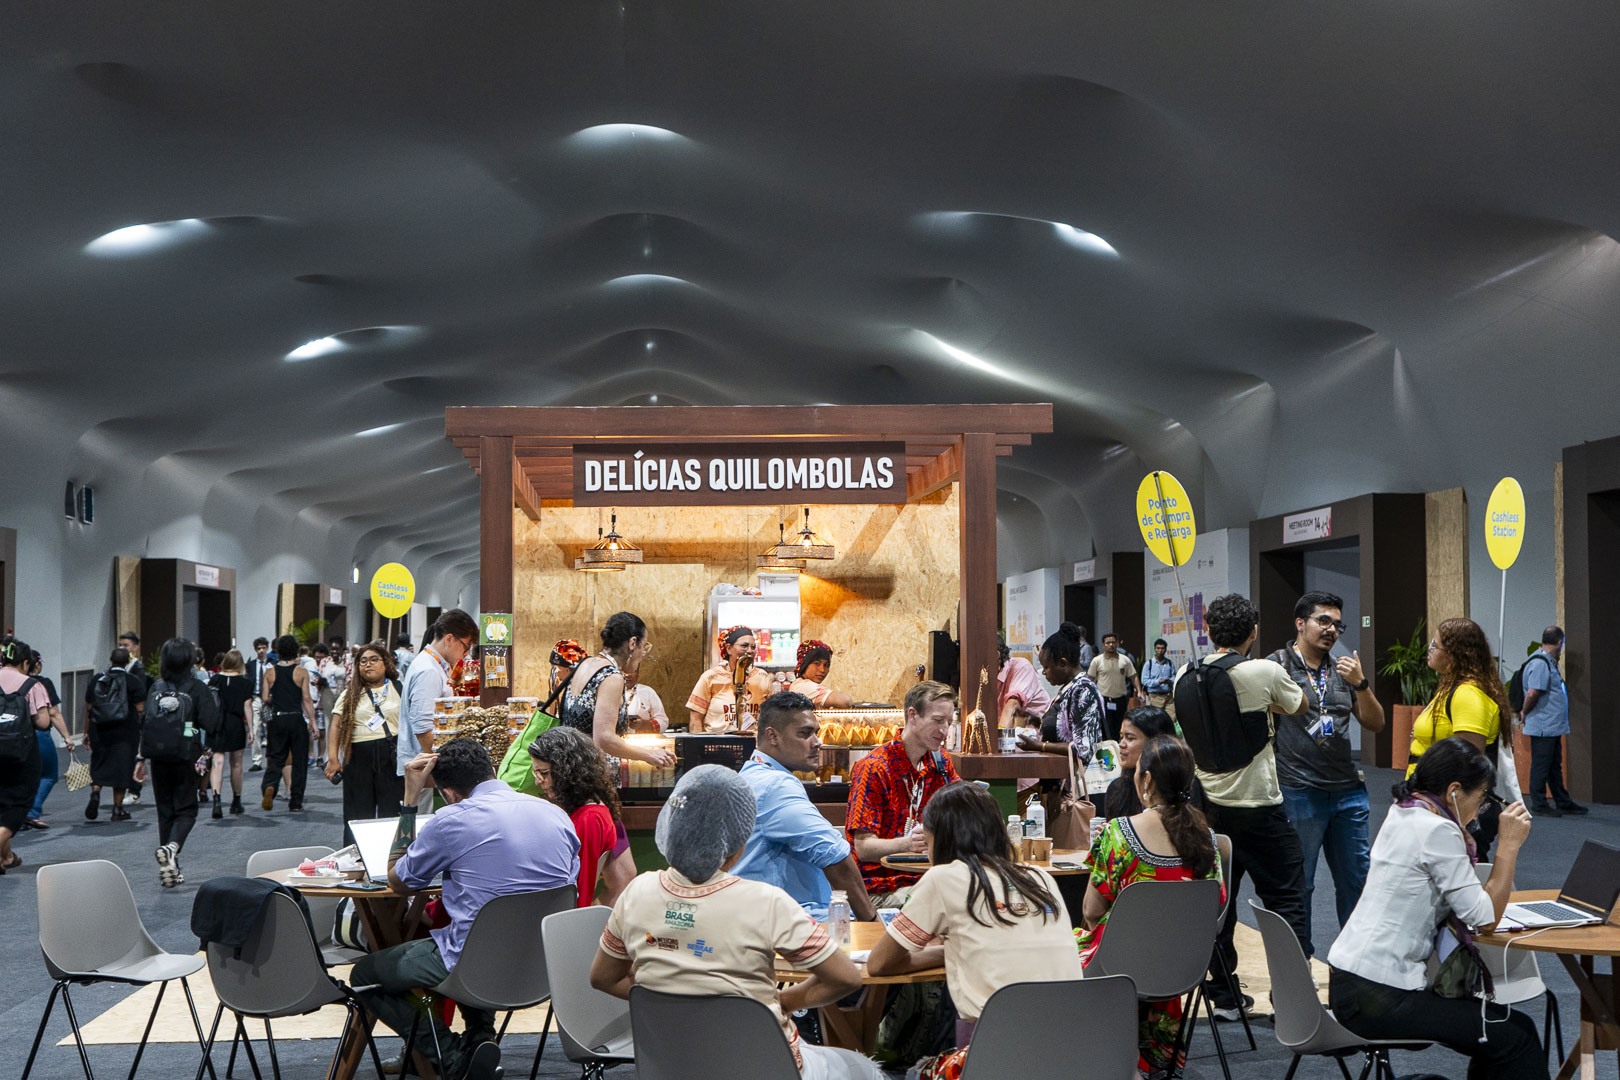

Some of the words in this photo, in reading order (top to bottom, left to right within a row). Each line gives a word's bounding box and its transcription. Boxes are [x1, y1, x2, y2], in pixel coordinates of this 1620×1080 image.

[585, 450, 701, 491] DELÍCIAS
[709, 457, 893, 491] QUILOMBOLAS
[1142, 514, 1153, 526] de
[1491, 511, 1519, 523] Cashless
[1148, 531, 1153, 540] e
[1492, 525, 1517, 536] Station
[378, 581, 408, 592] Cashless
[379, 590, 405, 600] Station
[666, 901, 698, 913] COP30
[665, 910, 695, 922] BRASIL
[687, 943, 713, 953] SEBRAE
